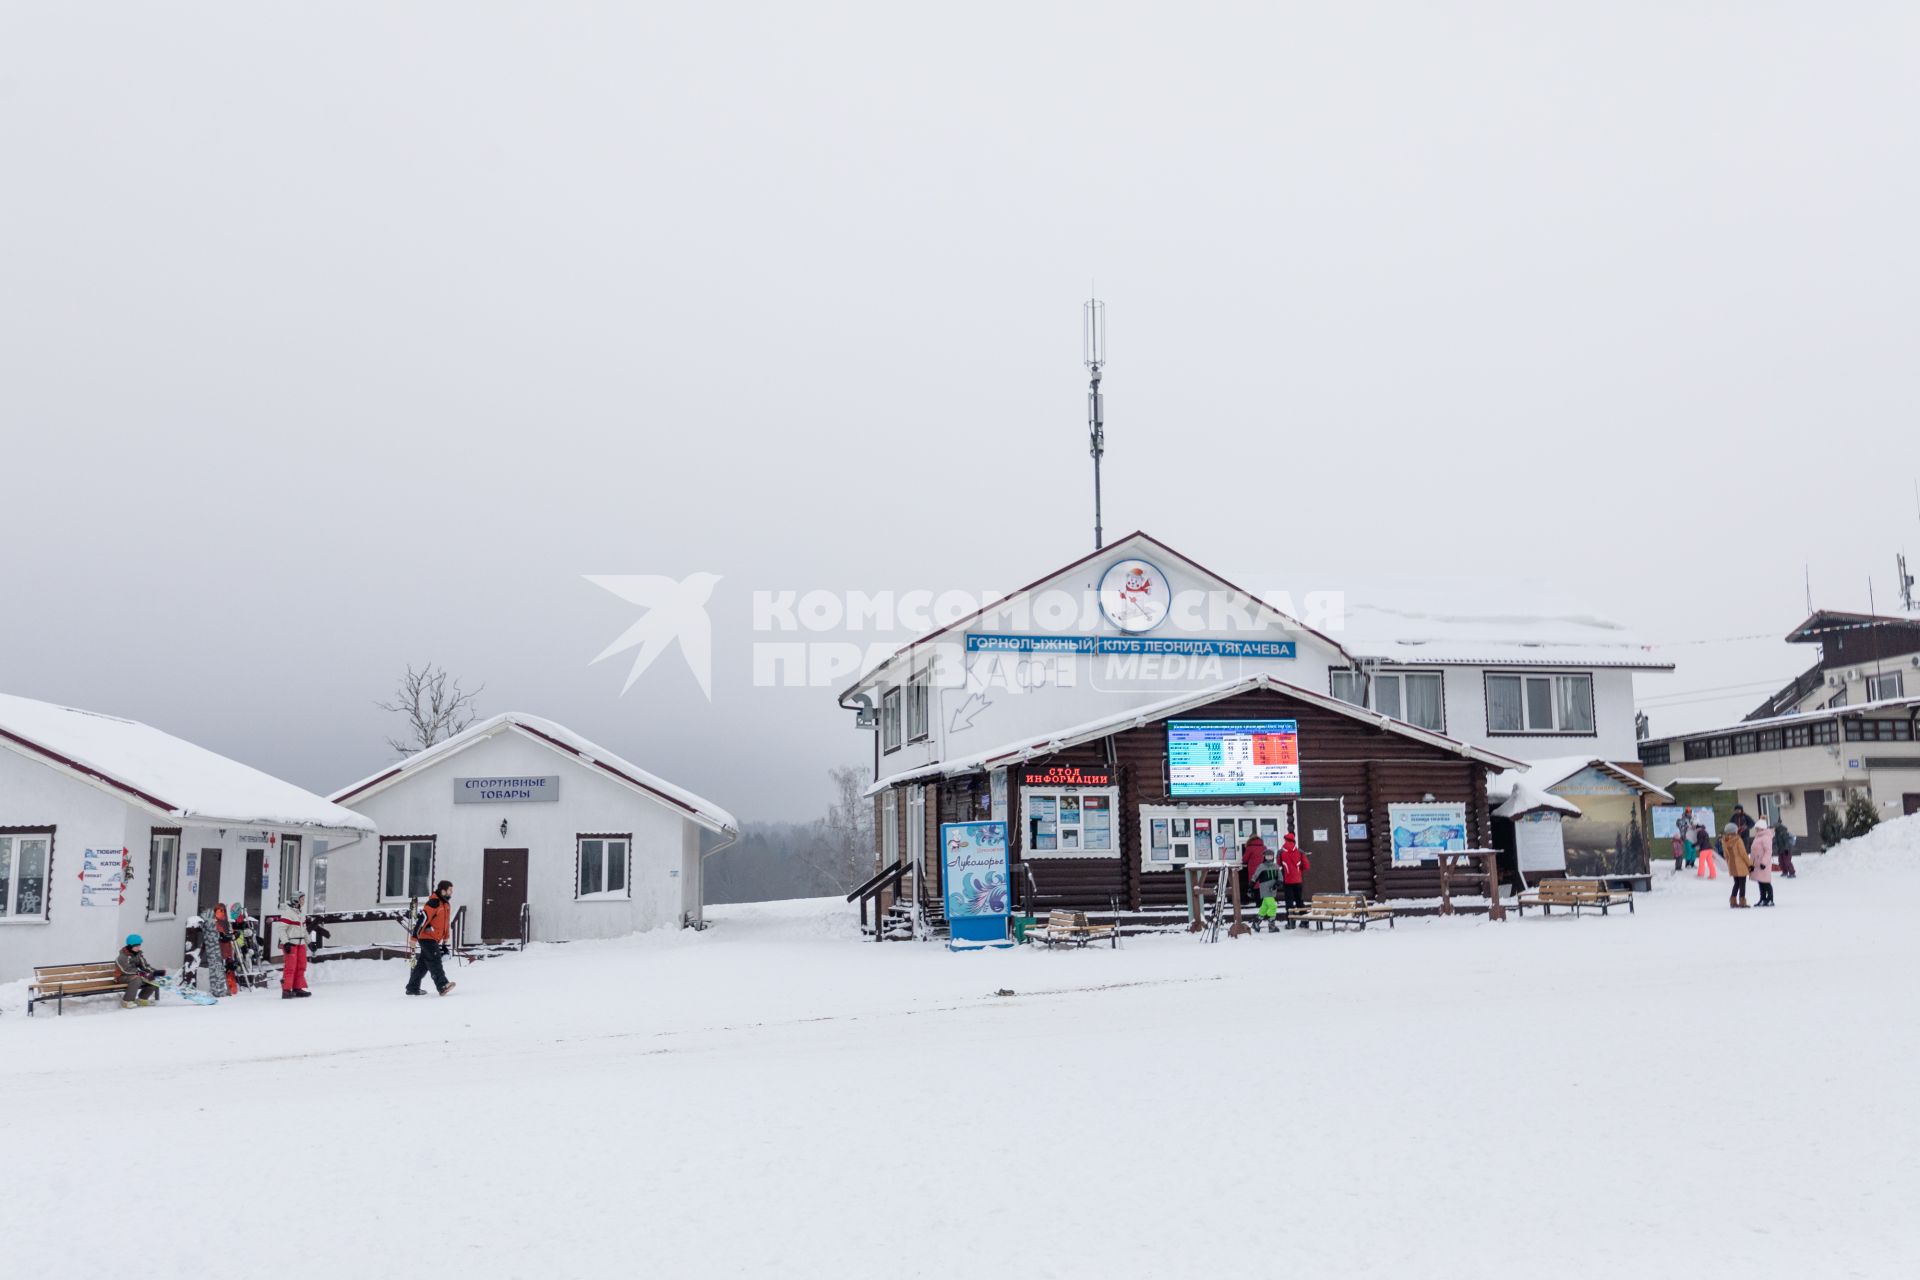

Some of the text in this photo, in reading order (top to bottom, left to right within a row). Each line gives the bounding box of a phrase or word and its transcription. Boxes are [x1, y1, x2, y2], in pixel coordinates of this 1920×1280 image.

[968, 636, 1290, 655] ГОРНОЛЫЖНЫЙ КЛУБ ЛЕОНИДА ТЯГАЧЕВА
[1048, 767, 1081, 776] СТОЛ
[465, 779, 546, 789] СПОРТИВНЫЕ
[1025, 775, 1108, 784] ИНФОРМАЦИИ
[480, 790, 531, 799] ТОВАРЫ
[947, 855, 1005, 871] Лукоморье
